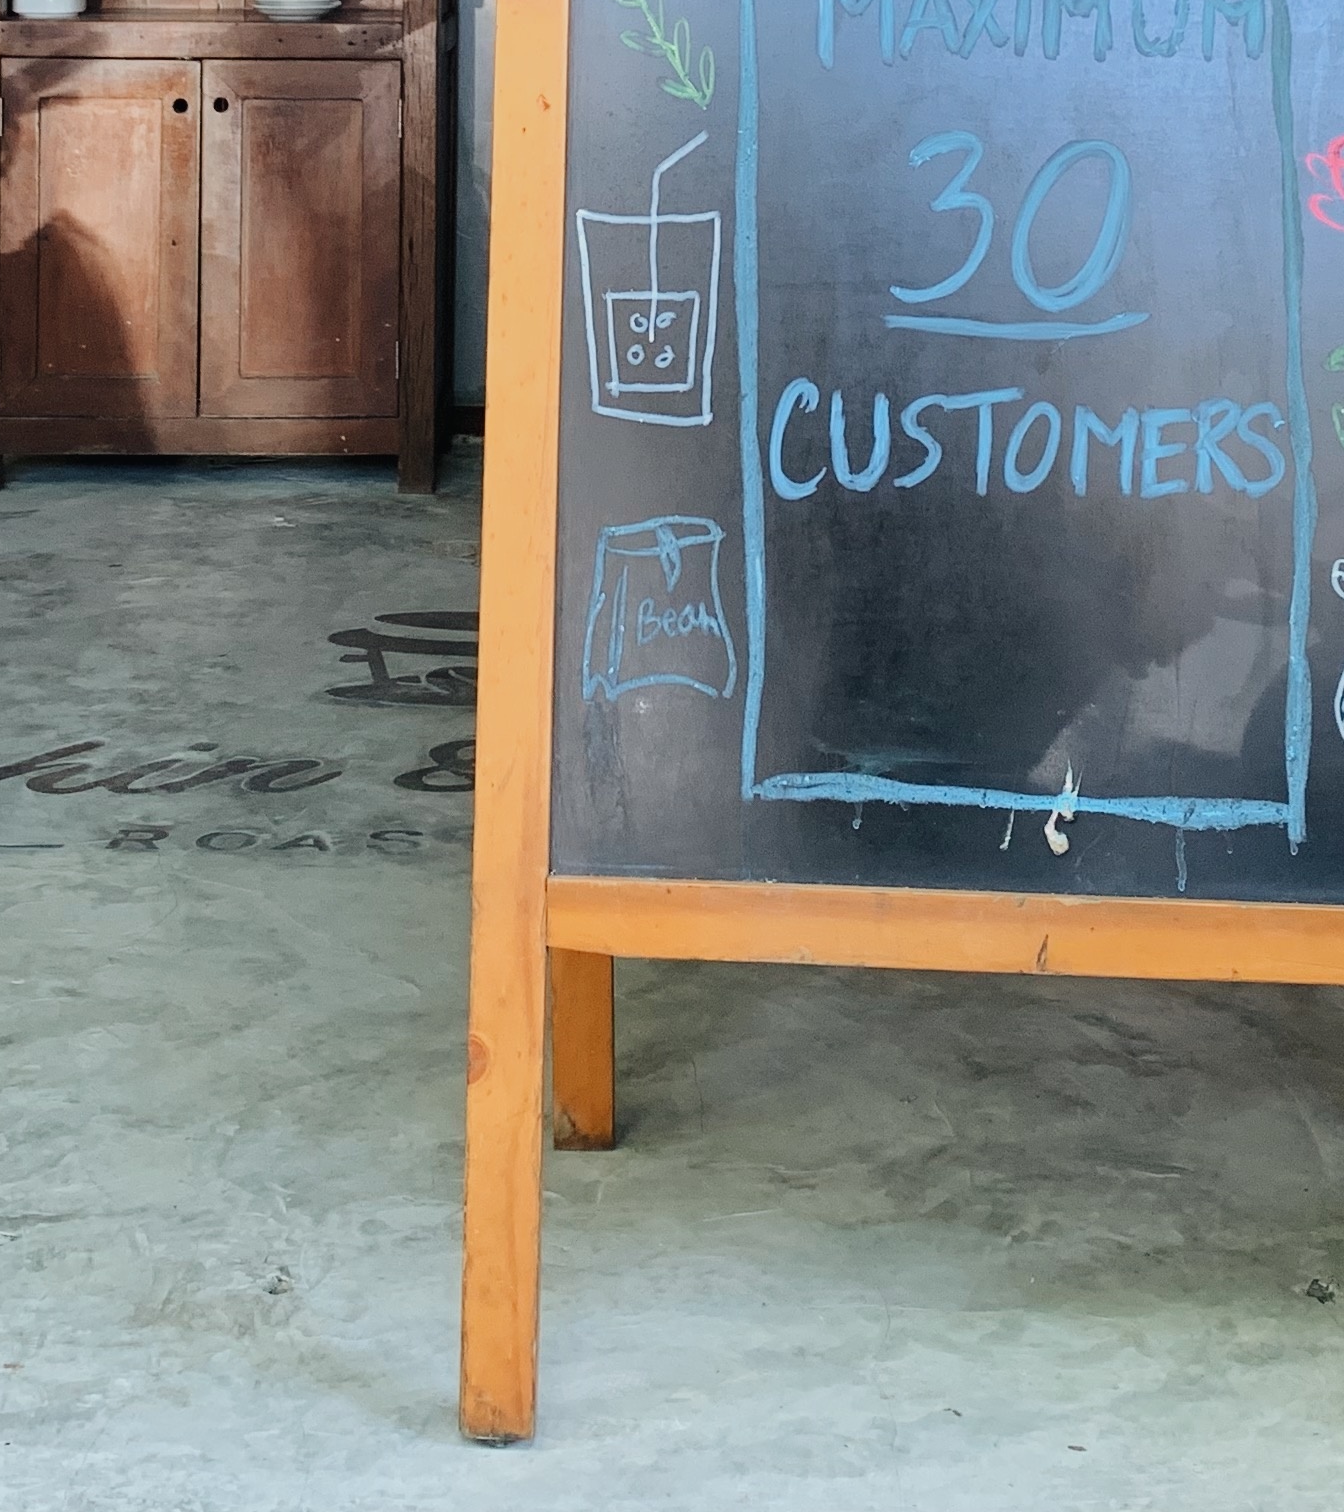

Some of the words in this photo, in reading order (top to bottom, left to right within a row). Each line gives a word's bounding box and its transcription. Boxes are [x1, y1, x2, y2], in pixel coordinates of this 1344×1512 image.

[889, 130, 1132, 312] 30
[769, 377, 1286, 500] CUSTOMERS
[636, 596, 723, 646] Bean
